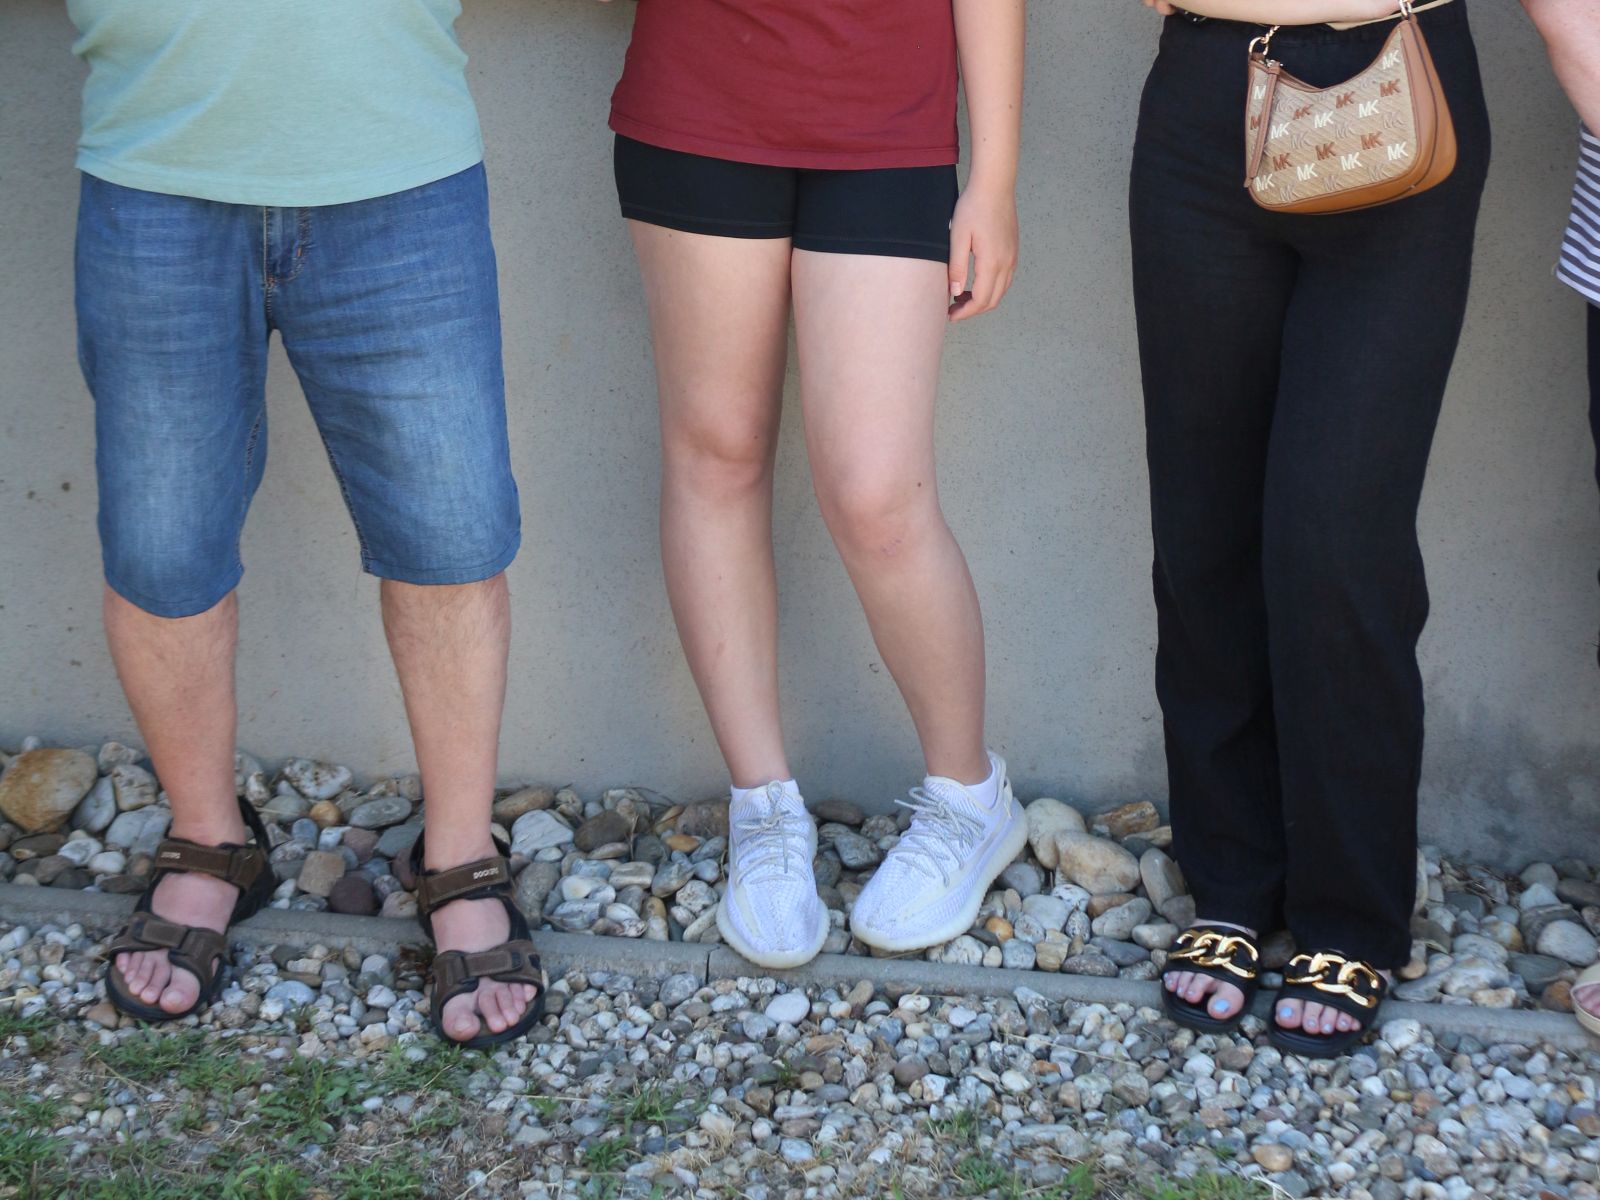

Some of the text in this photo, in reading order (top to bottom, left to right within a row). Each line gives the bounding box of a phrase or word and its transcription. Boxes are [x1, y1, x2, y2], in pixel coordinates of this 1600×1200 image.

[1382, 50, 1400, 69] MK
[1254, 86, 1266, 99] M
[1337, 91, 1355, 109] MK
[1380, 79, 1400, 97] MK
[1271, 100, 1379, 139] MK MK MK
[1255, 142, 1408, 191] MK MK MK MK
[1273, 132, 1383, 171] MK MK MK
